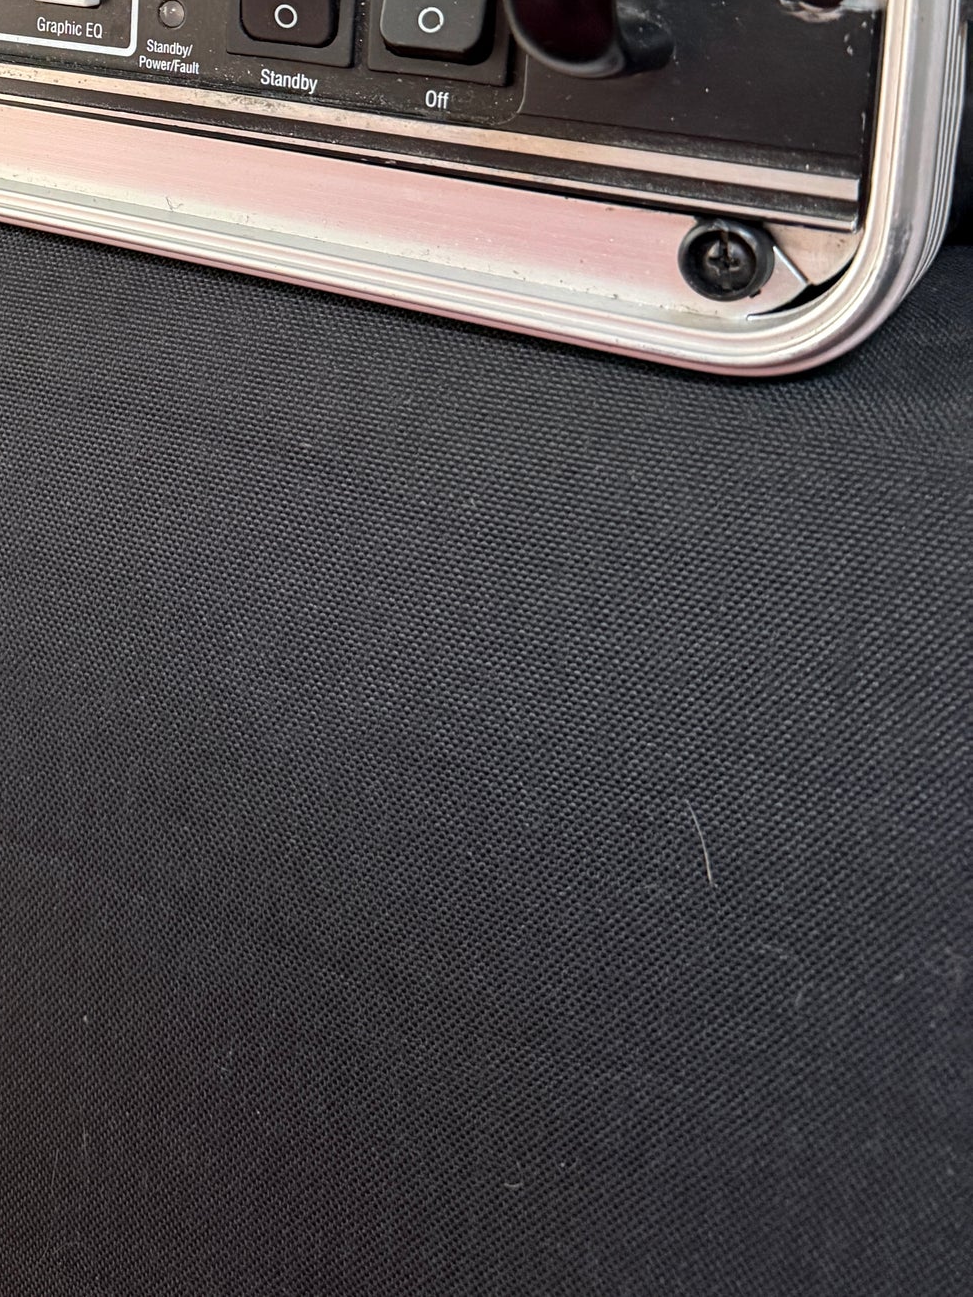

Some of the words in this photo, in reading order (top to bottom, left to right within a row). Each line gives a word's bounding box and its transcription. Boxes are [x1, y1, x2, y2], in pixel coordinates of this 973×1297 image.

[36, 17, 82, 39] Graphic
[85, 22, 103, 39] EQ
[146, 39, 193, 58] Standby/
[139, 55, 201, 75] Power/Fault
[260, 68, 318, 93] Standby
[425, 89, 449, 109] Off
